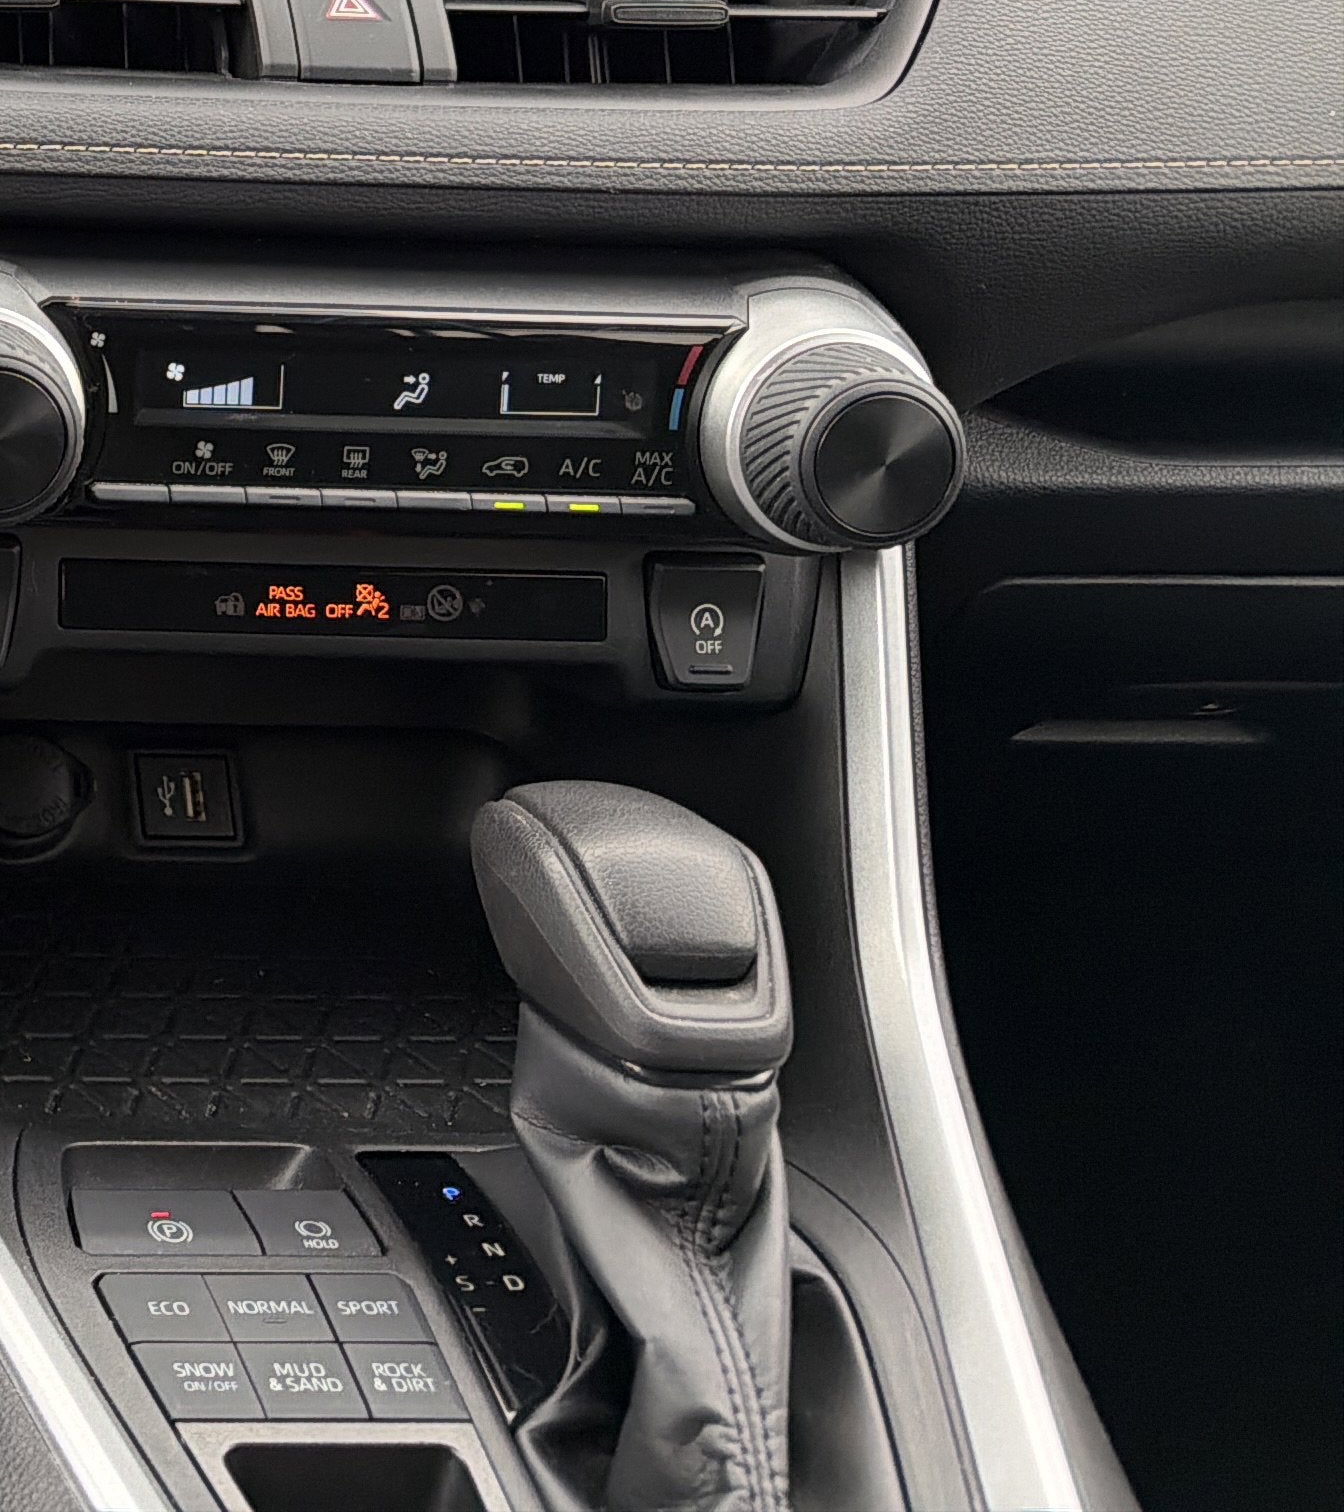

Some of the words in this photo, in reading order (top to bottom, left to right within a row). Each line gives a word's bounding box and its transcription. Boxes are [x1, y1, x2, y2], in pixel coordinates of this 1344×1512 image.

[537, 373, 566, 385] TEMP
[635, 451, 673, 466] MAX
[172, 461, 234, 477] ON/OFF
[263, 467, 295, 477] FRONT
[342, 469, 368, 479] REAR
[560, 458, 602, 479] A/C
[631, 467, 673, 486] A/C
[269, 586, 304, 600] PASS
[256, 603, 281, 617] AIR
[286, 603, 316, 618] BAG
[325, 604, 353, 618] OFF
[695, 640, 722, 654] OFF
[463, 1213, 485, 1228] R
[303, 1238, 339, 1250] HOLD
[482, 1241, 506, 1257] N
[455, 1274, 475, 1292] S
[502, 1274, 525, 1292] D
[147, 1300, 190, 1317] ECO
[228, 1300, 313, 1316] NORMAL
[337, 1300, 400, 1316] SPORT
[172, 1362, 234, 1378] SNOW
[273, 1362, 325, 1377] MUD
[372, 1362, 426, 1377] ROCK
[269, 1377, 283, 1392] &
[286, 1377, 343, 1392] SAND
[372, 1377, 387, 1392] &
[392, 1377, 438, 1393] DIRT
